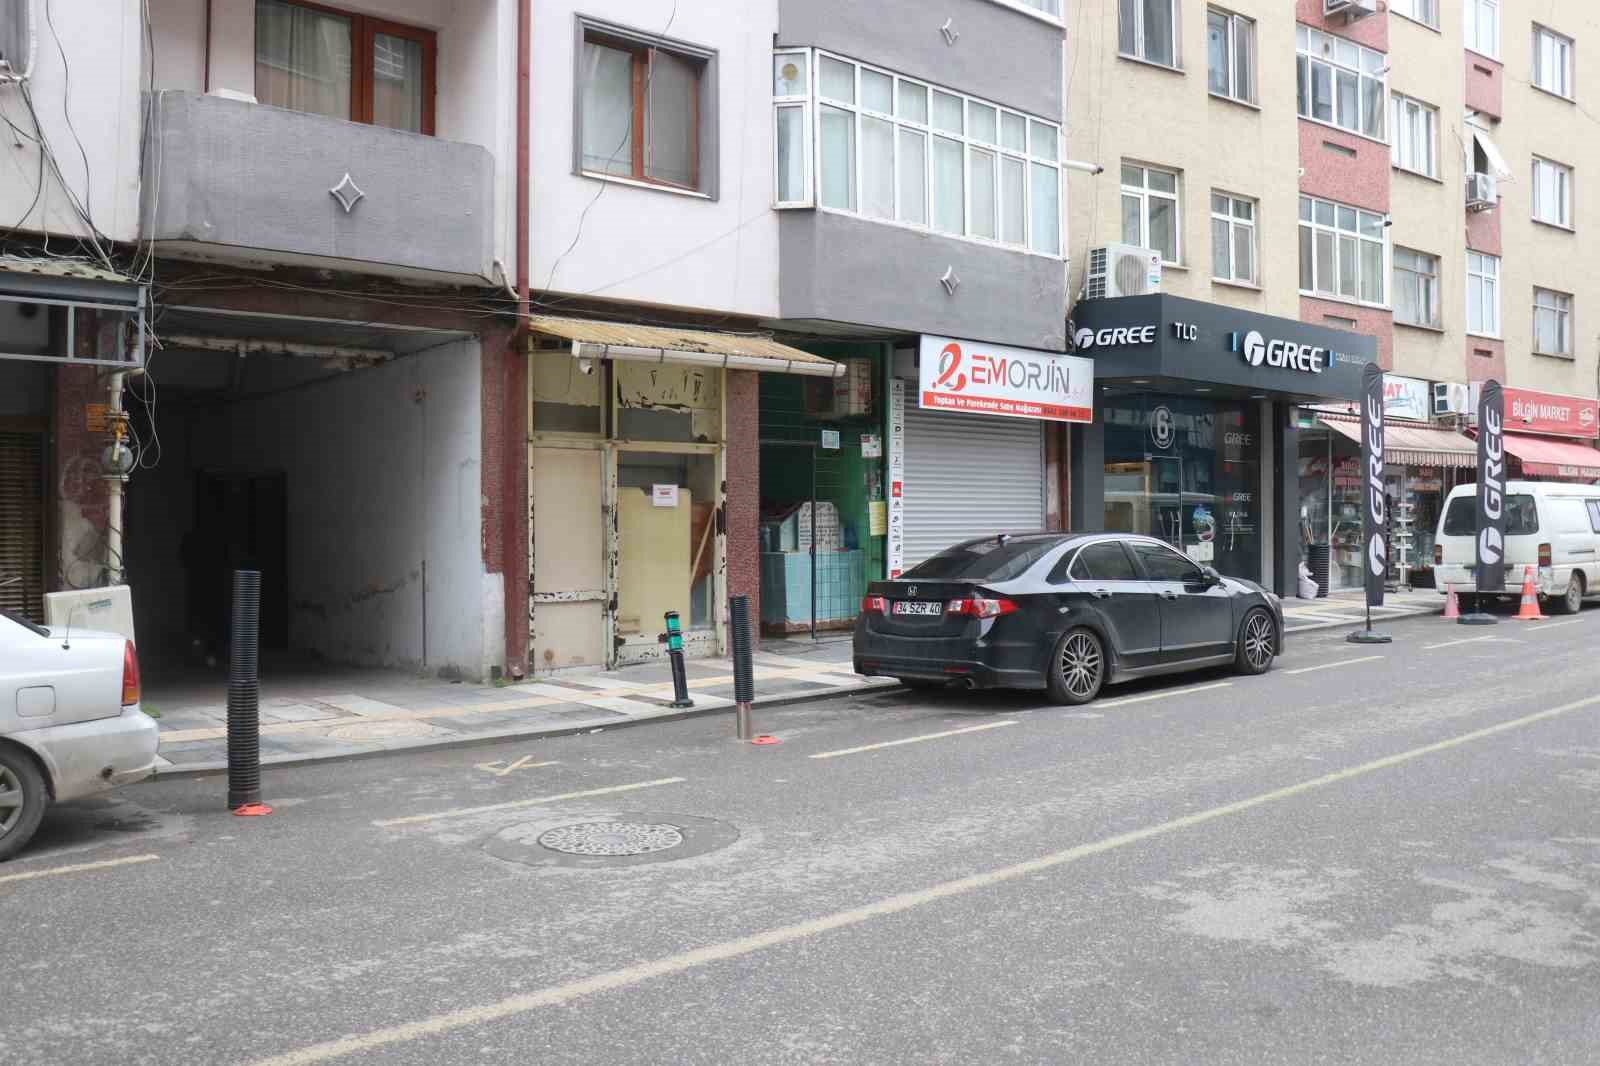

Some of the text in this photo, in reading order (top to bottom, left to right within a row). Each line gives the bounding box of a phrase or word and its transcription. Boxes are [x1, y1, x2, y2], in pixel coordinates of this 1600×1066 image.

[1095, 325, 1156, 346] GREE
[1266, 339, 1324, 373] GREE
[1512, 398, 1538, 418] BİLGİN
[1539, 404, 1570, 422] MARKET
[1224, 432, 1253, 446] GREE
[1367, 394, 1384, 525] GREE
[1484, 405, 1502, 520] GREE
[1232, 492, 1253, 502] GREE
[896, 602, 907, 613] 34
[910, 602, 926, 615] SZR
